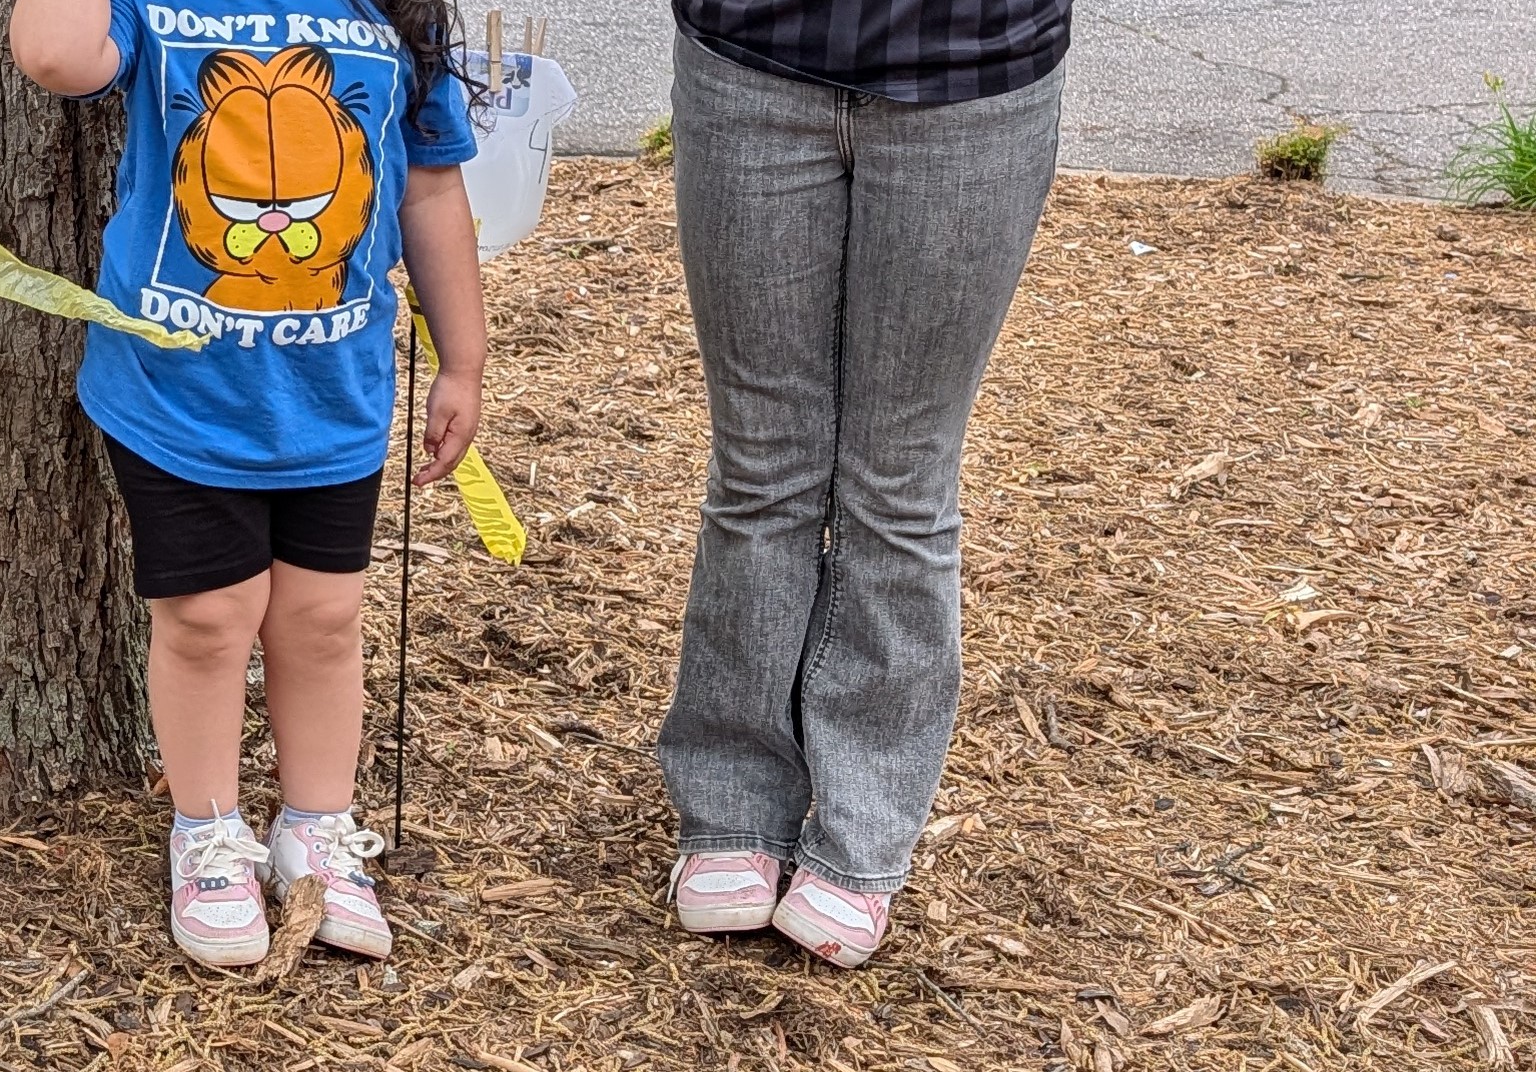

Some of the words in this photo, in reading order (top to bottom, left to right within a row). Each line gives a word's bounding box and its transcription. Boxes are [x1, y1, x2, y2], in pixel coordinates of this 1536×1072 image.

[147, 5, 276, 43] DON'T
[286, 13, 402, 54] KNOW
[528, 119, 550, 184] 4
[140, 288, 264, 348] DON'T
[272, 303, 371, 346] CARE
